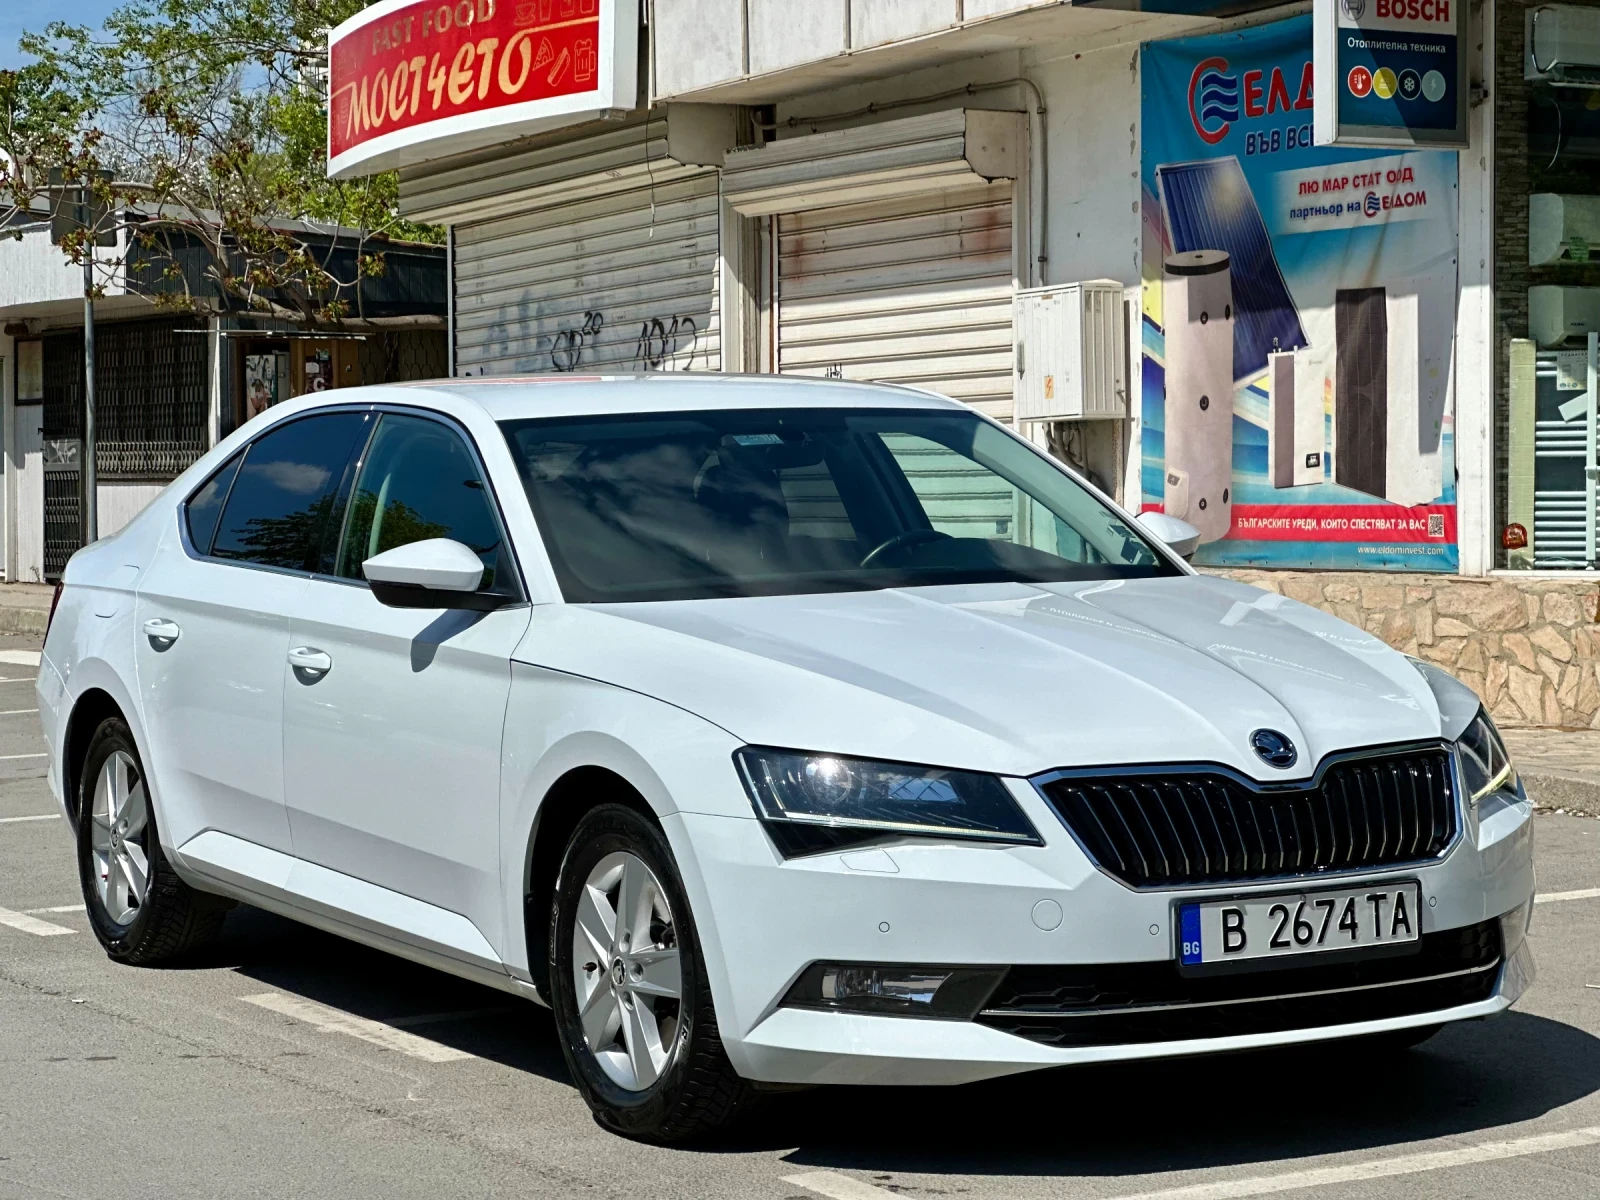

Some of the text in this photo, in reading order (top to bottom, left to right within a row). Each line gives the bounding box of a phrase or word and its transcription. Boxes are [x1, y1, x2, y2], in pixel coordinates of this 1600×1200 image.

[1376, 0, 1450, 22] BOSCH
[372, 0, 497, 56] FAST FOOD
[1347, 37, 1447, 54] Отоплителна техника
[1245, 127, 1281, 156] ВЪВ
[1298, 180, 1320, 195] ЛЮ
[1322, 177, 1349, 193] МАР
[1352, 172, 1382, 188] СТАТ
[1290, 203, 1344, 220] партньор
[1347, 201, 1361, 212] на
[1238, 517, 1426, 531] БЪЛГАРСКИТЕ УРЕДИ, КОИТО СПЕСТЯВАТ ЗА ВАС
[1358, 544, 1444, 556] www.eldominvest.com
[1183, 941, 1200, 956] BG
